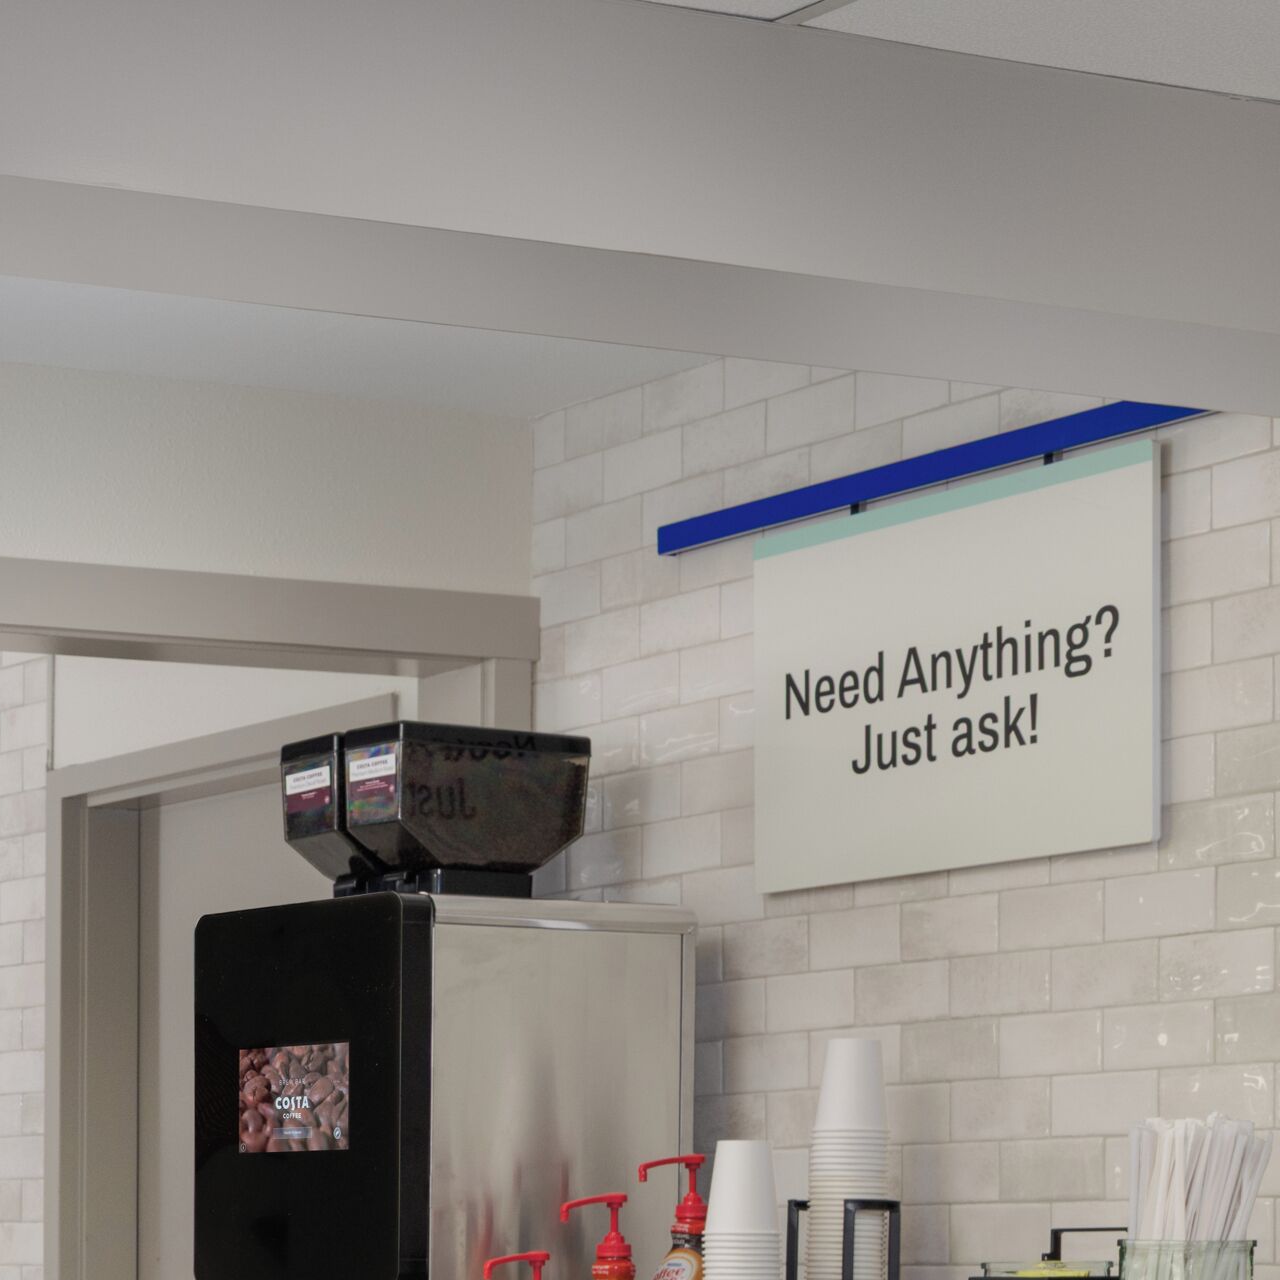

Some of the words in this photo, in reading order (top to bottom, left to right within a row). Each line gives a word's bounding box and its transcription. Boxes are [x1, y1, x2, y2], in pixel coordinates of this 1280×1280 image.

[784, 651, 885, 720] Need
[897, 604, 1121, 699] Anything?
[851, 713, 937, 775] Just
[951, 693, 1039, 758] ask!
[275, 1095, 309, 1111] COSTA
[282, 1112, 302, 1120] COFFEE
